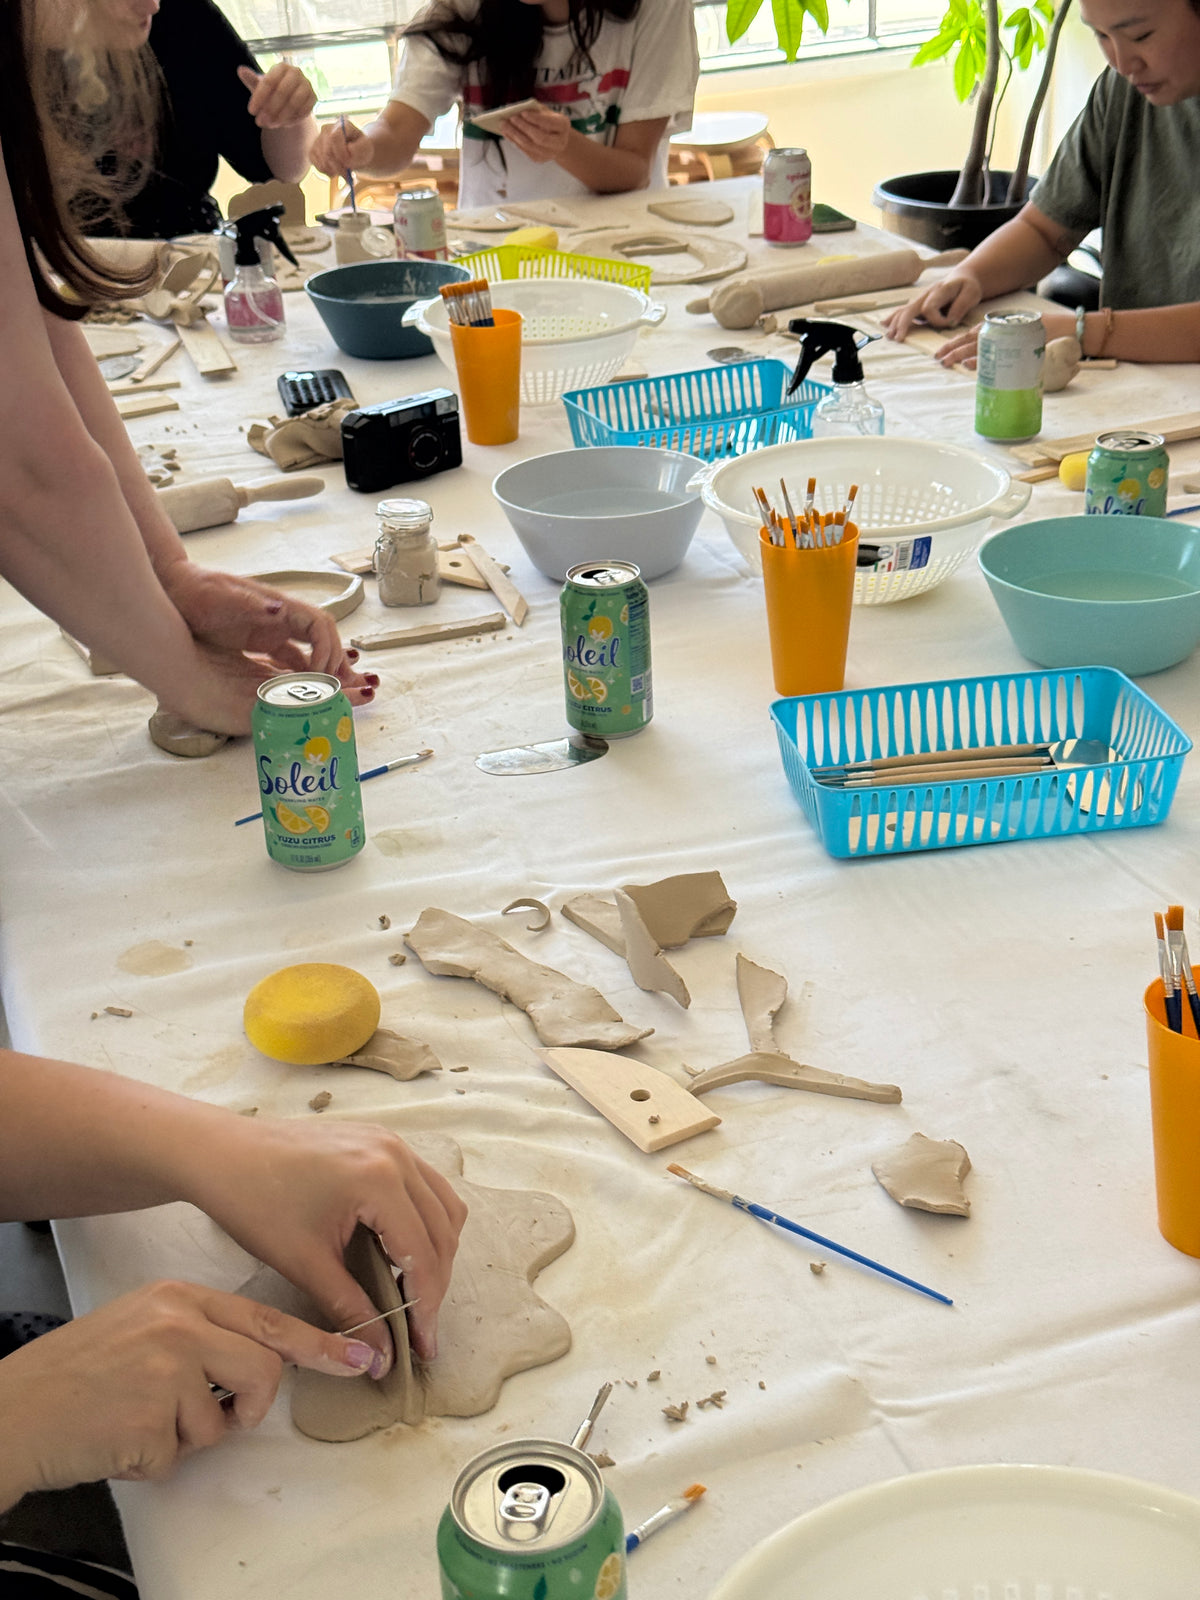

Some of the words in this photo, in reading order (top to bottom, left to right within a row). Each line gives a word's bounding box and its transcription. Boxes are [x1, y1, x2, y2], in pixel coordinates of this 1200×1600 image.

[563, 634, 623, 668] oleil
[582, 705, 613, 713] CITRUS
[259, 755, 342, 796] Soleil
[277, 834, 300, 844] YUZU
[302, 834, 336, 845] CITRUS
